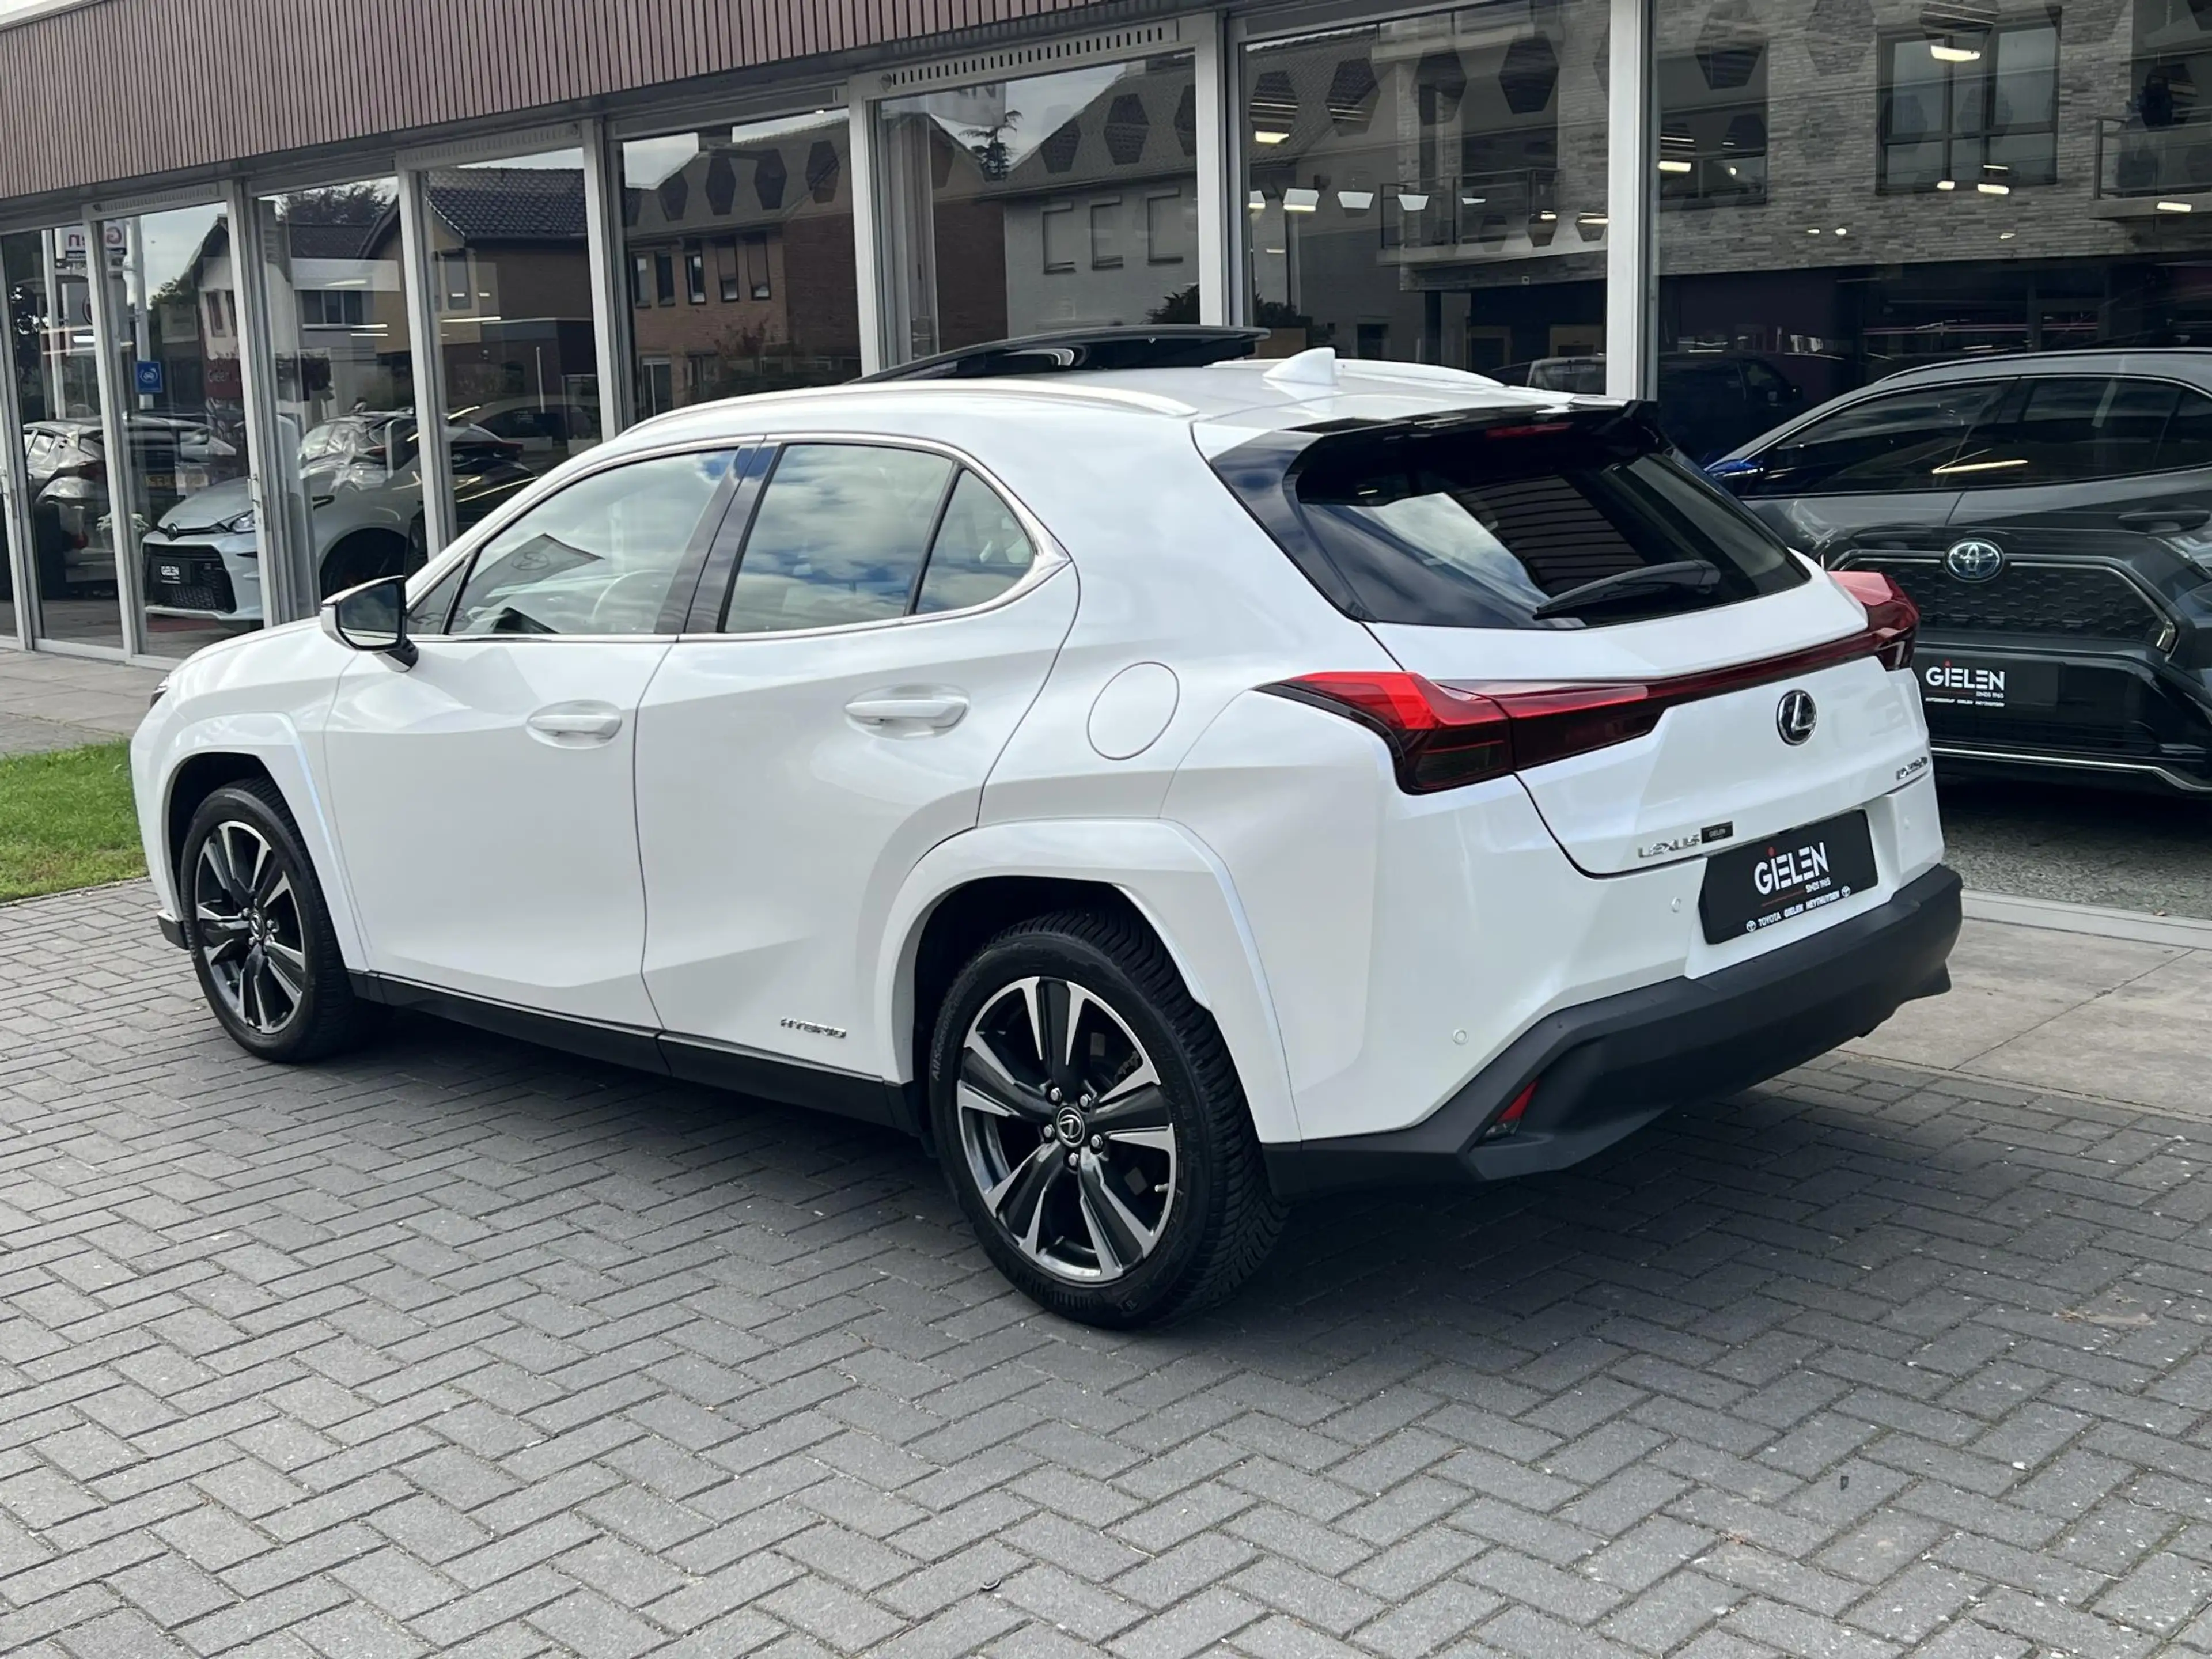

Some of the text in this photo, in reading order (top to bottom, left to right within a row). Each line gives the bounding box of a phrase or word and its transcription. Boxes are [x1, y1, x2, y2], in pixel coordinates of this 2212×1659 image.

[1926, 661, 2005, 691] GIELEN
[1638, 834, 1700, 858] LEXUS
[1754, 841, 1830, 895] GIELEN
[1758, 912, 1782, 927] TOYOTA
[1784, 904, 1804, 918] GIELEN
